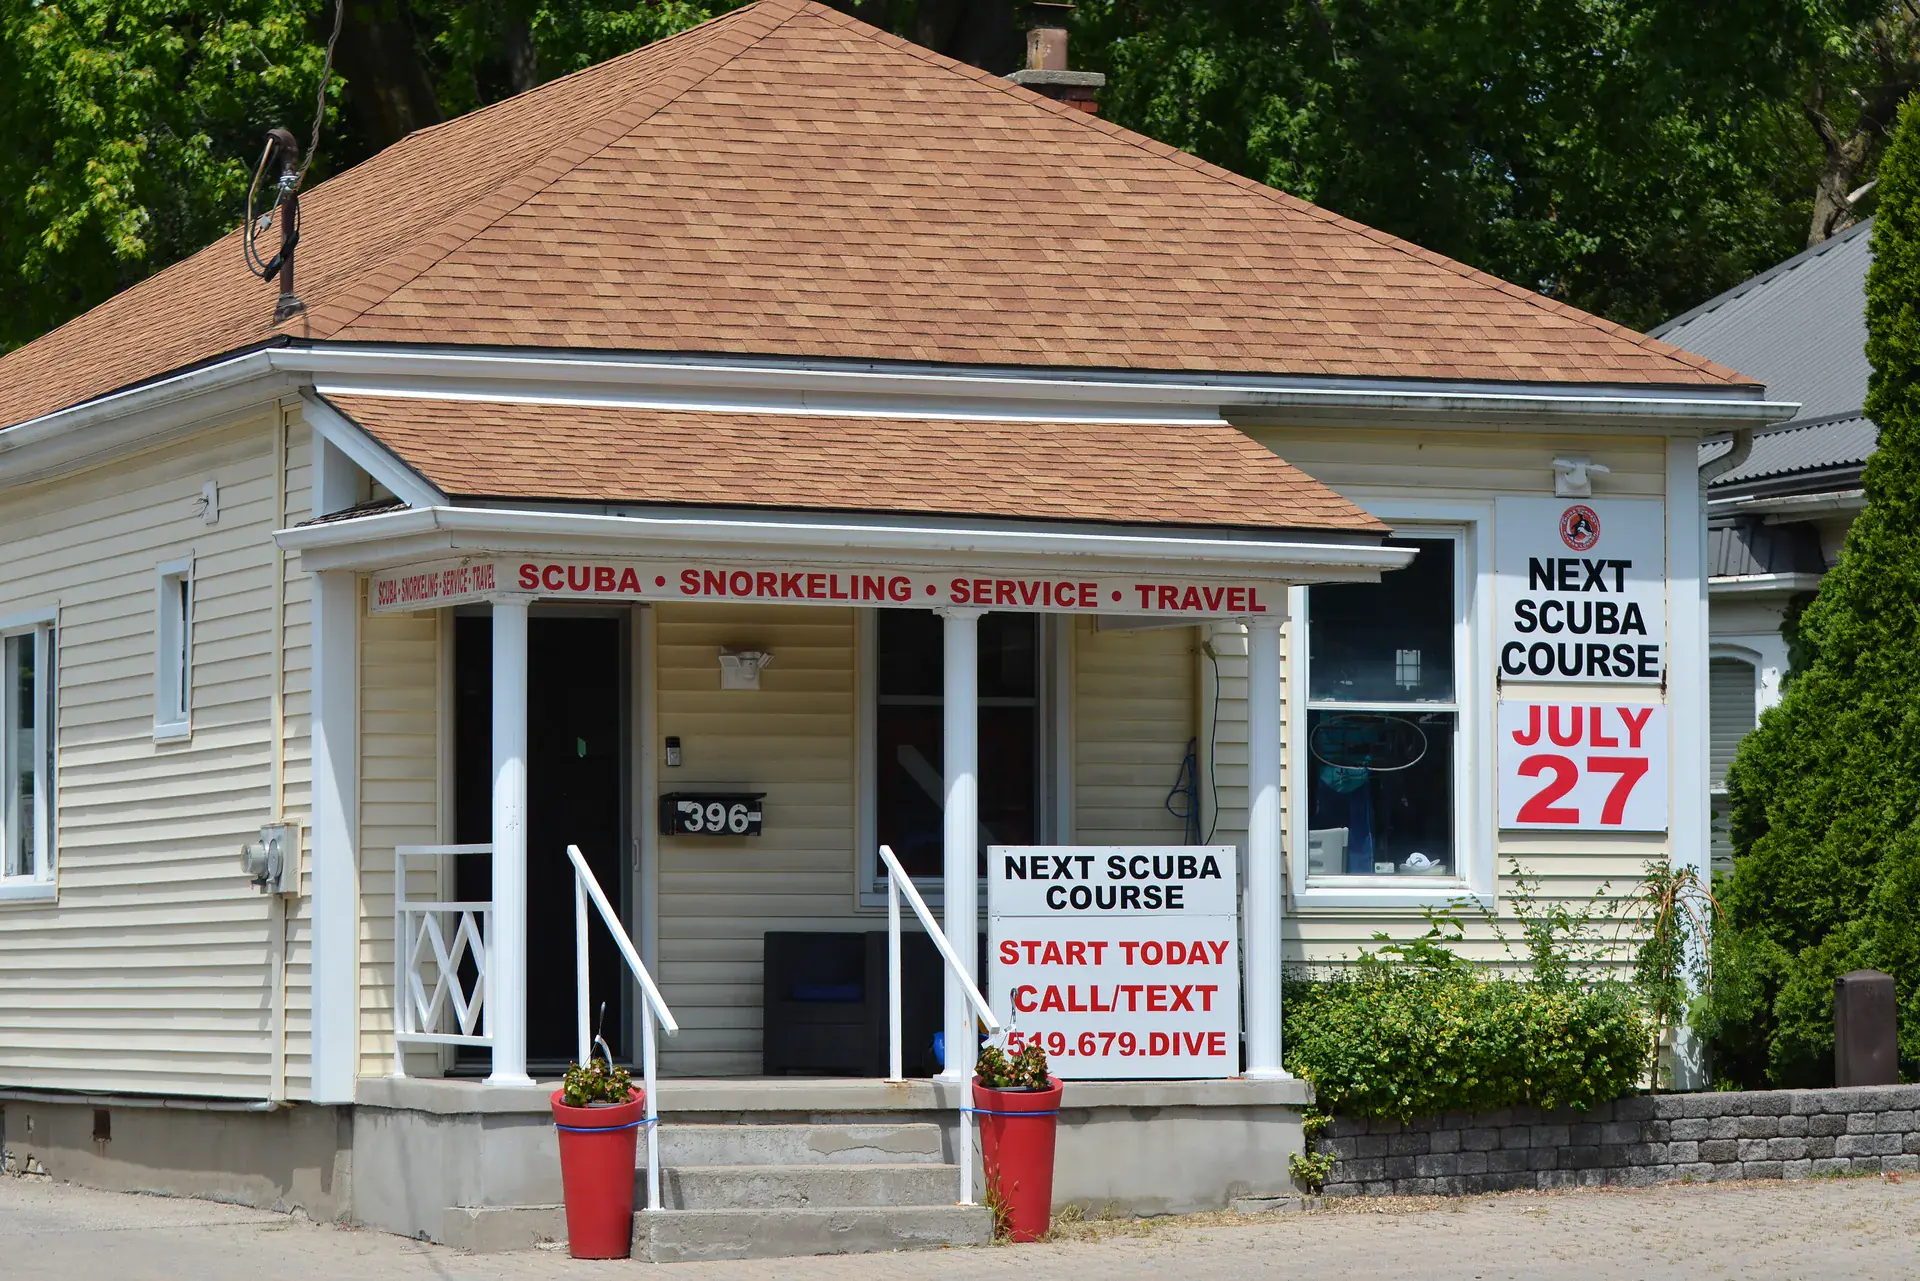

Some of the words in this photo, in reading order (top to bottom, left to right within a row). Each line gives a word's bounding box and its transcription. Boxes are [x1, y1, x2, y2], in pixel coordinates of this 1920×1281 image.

[378, 579, 397, 605] SCUBA
[401, 572, 438, 602] SNORKELING
[442, 567, 468, 596] SERVICE
[472, 563, 496, 591] TRAVEL
[518, 563, 642, 593] SCUBA
[679, 569, 912, 602] SNORKELING
[950, 578, 1098, 608] SERVICE
[1134, 584, 1267, 612] TRAVEL
[1528, 556, 1633, 593] NEXT
[1514, 599, 1648, 636] SCUBA
[1501, 641, 1660, 678] COURSE
[1512, 704, 1655, 749] JULY
[1516, 754, 1649, 825] 27
[684, 802, 749, 834] 396
[1004, 855, 1095, 880] NEXT
[1106, 855, 1222, 880] SCUBA
[1046, 885, 1185, 910] COURSE
[999, 940, 1109, 966] START
[1118, 940, 1230, 966] TODAY
[1013, 984, 1219, 1013] CALL/TEXT
[1006, 1031, 1227, 1057] 519.679.DIVE
